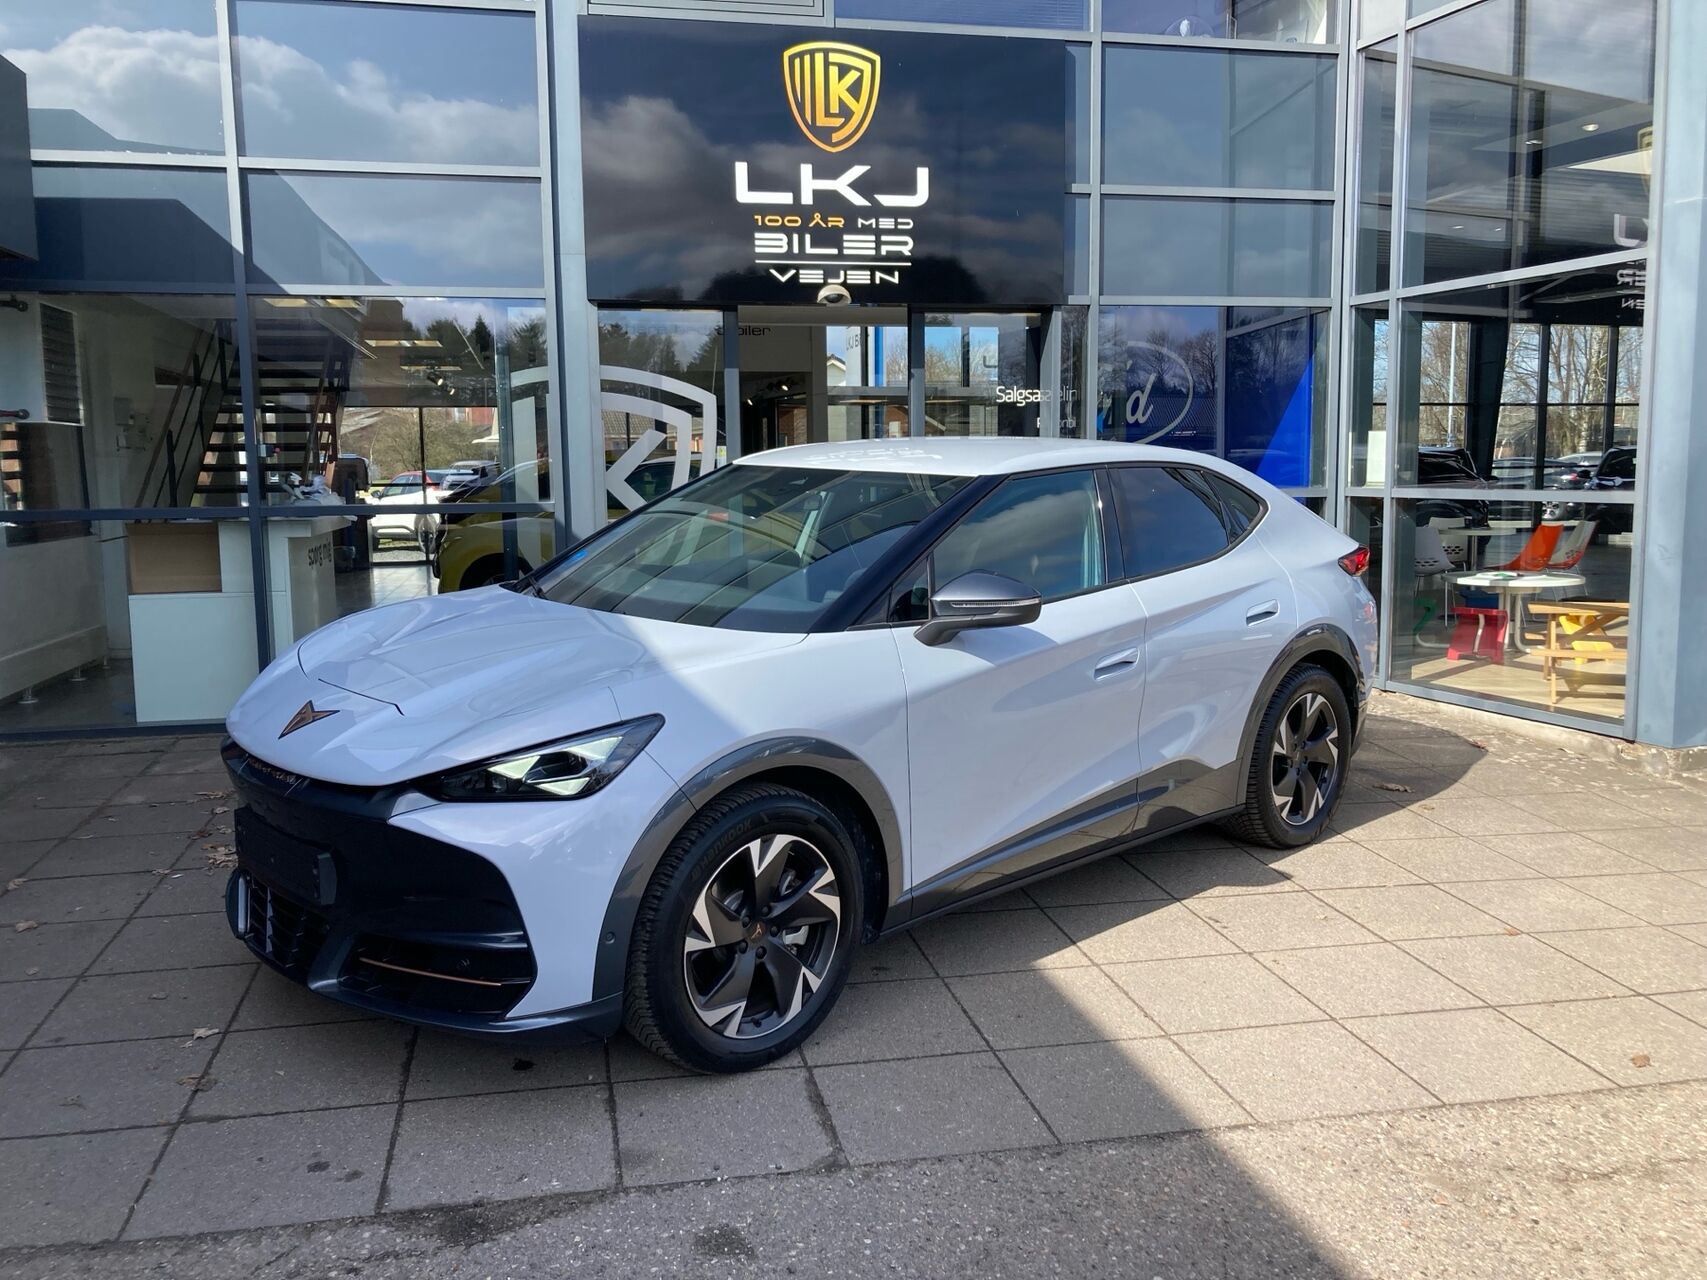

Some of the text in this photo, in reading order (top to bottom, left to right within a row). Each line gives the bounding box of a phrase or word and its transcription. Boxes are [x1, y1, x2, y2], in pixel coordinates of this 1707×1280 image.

[734, 160, 930, 208] LKJ
[754, 212, 914, 230] 100 ÅR MED
[754, 232, 915, 256] BILER
[769, 268, 900, 285] VEJEN
